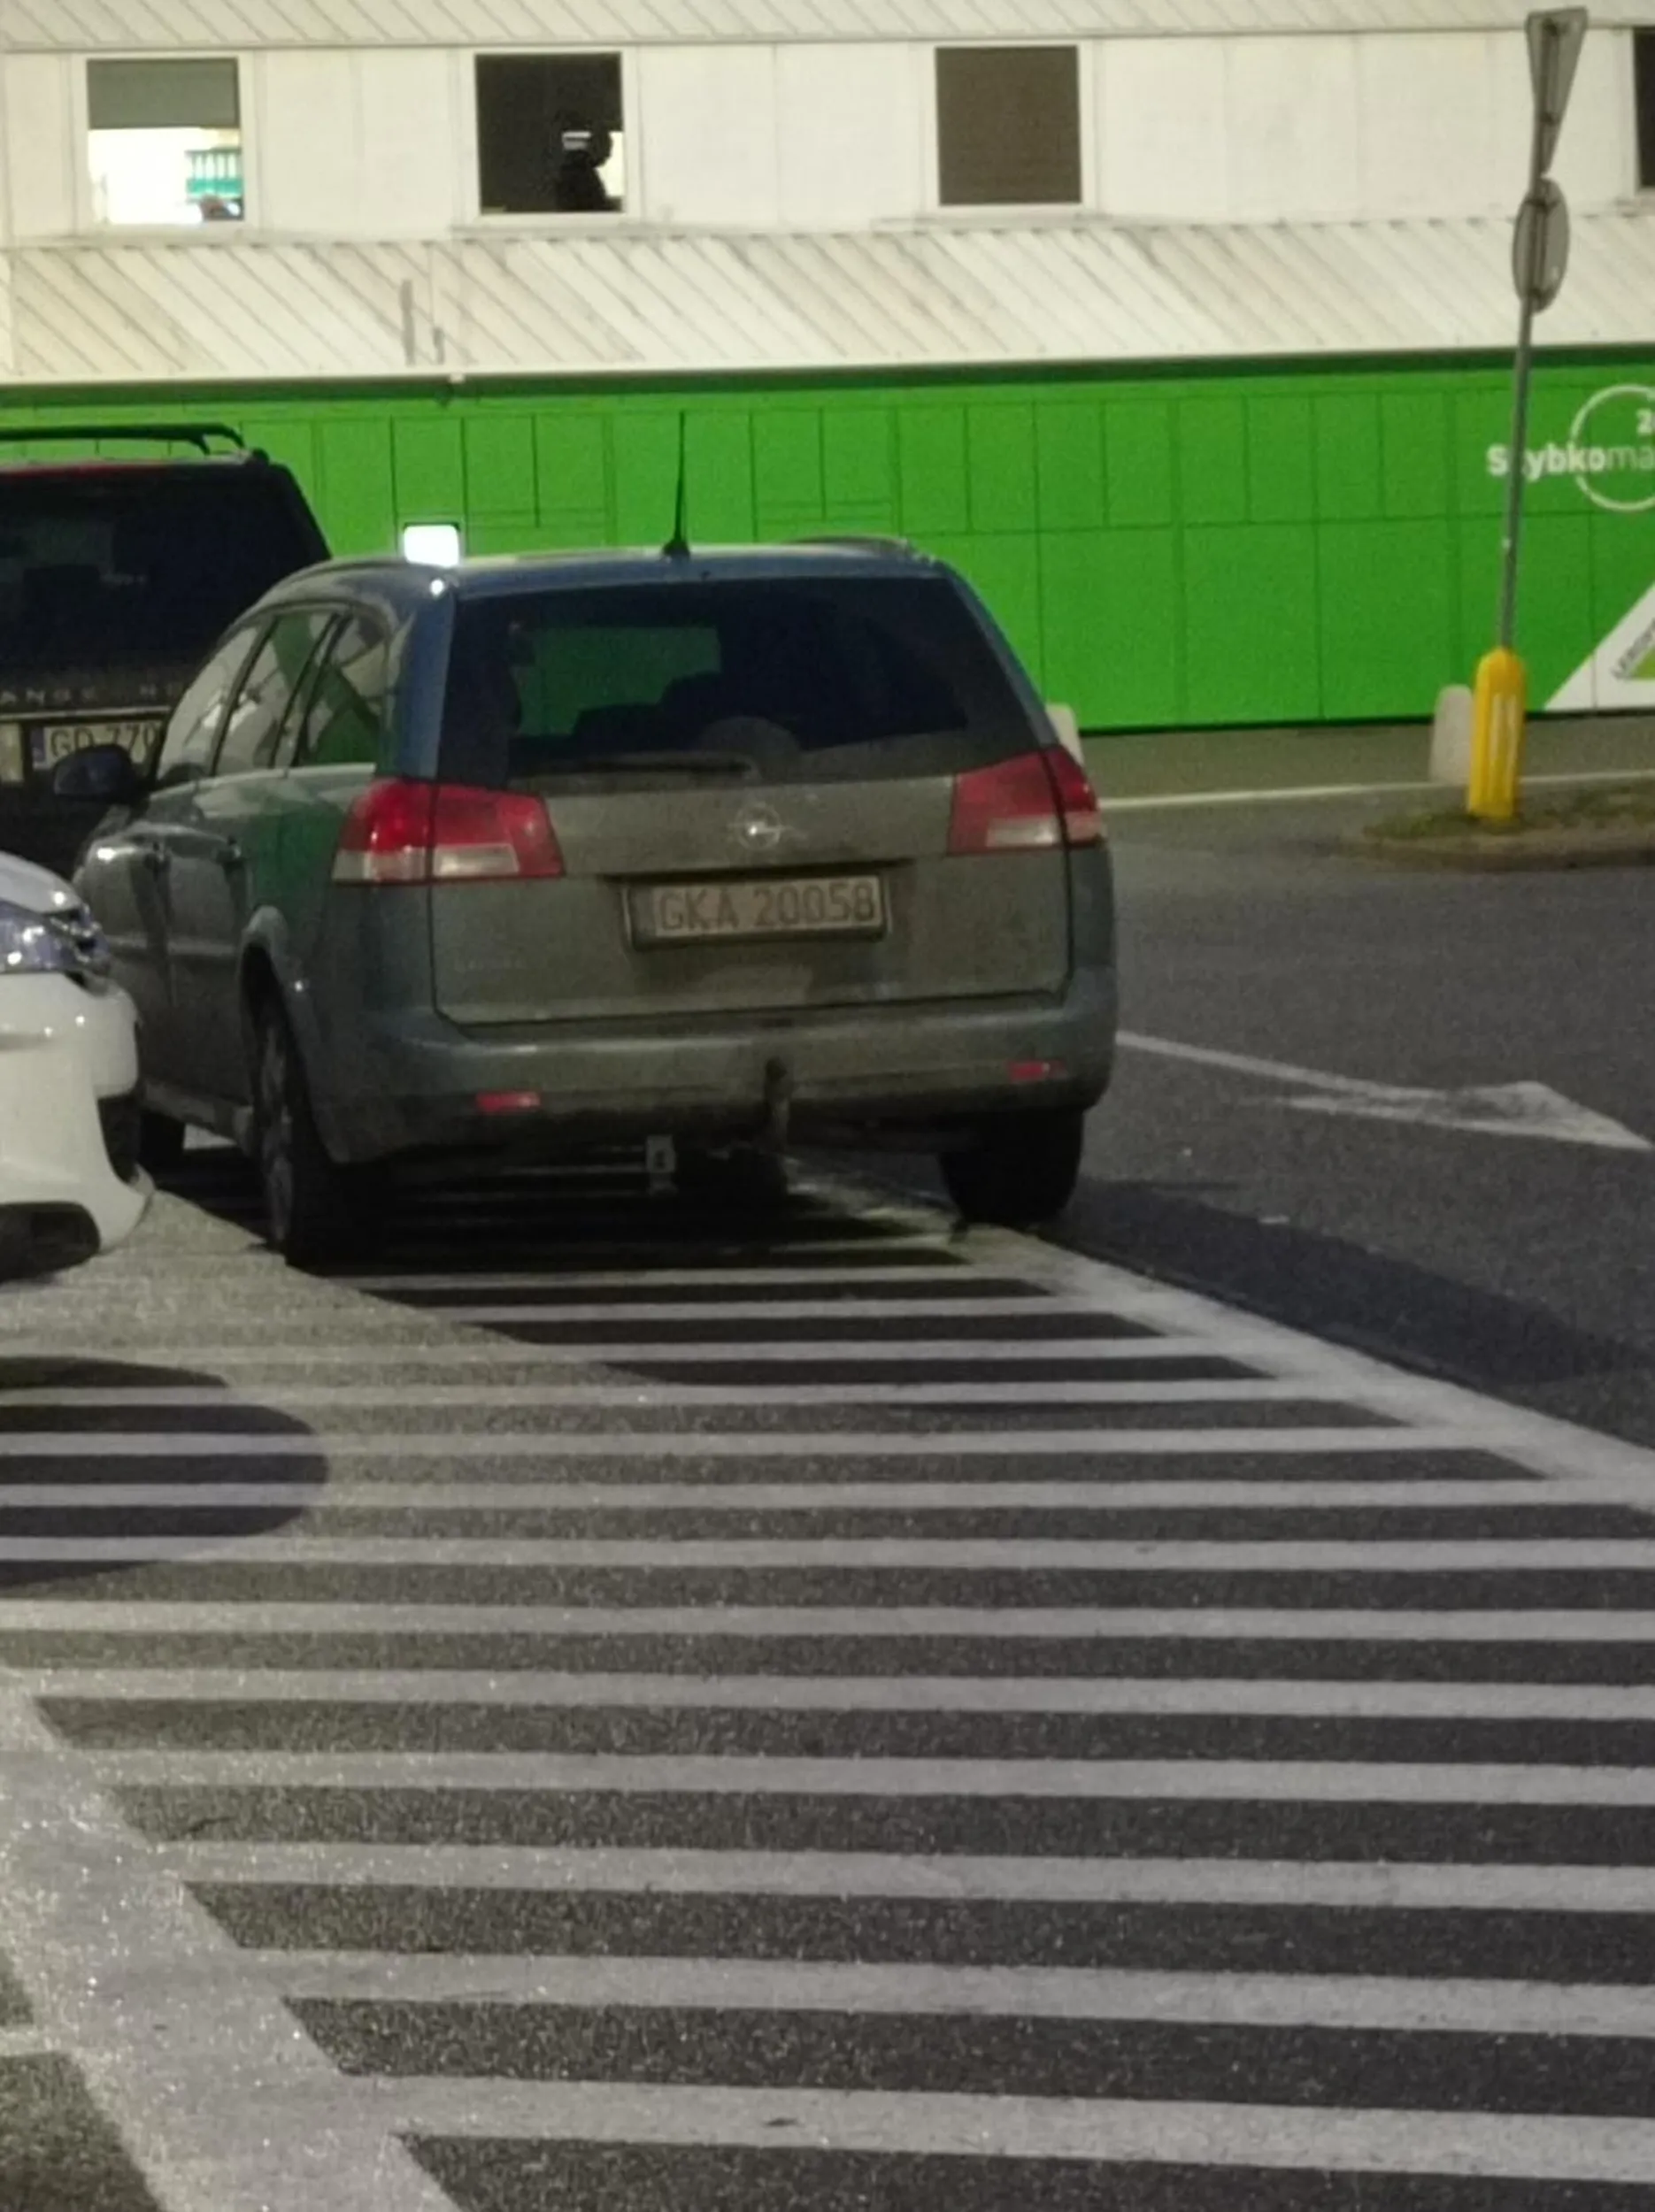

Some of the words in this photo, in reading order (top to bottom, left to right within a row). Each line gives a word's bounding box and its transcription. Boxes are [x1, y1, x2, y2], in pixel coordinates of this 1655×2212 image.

[1486, 442, 1655, 483] Sybkoma
[658, 887, 739, 930] GKA
[752, 881, 874, 927] 20058
